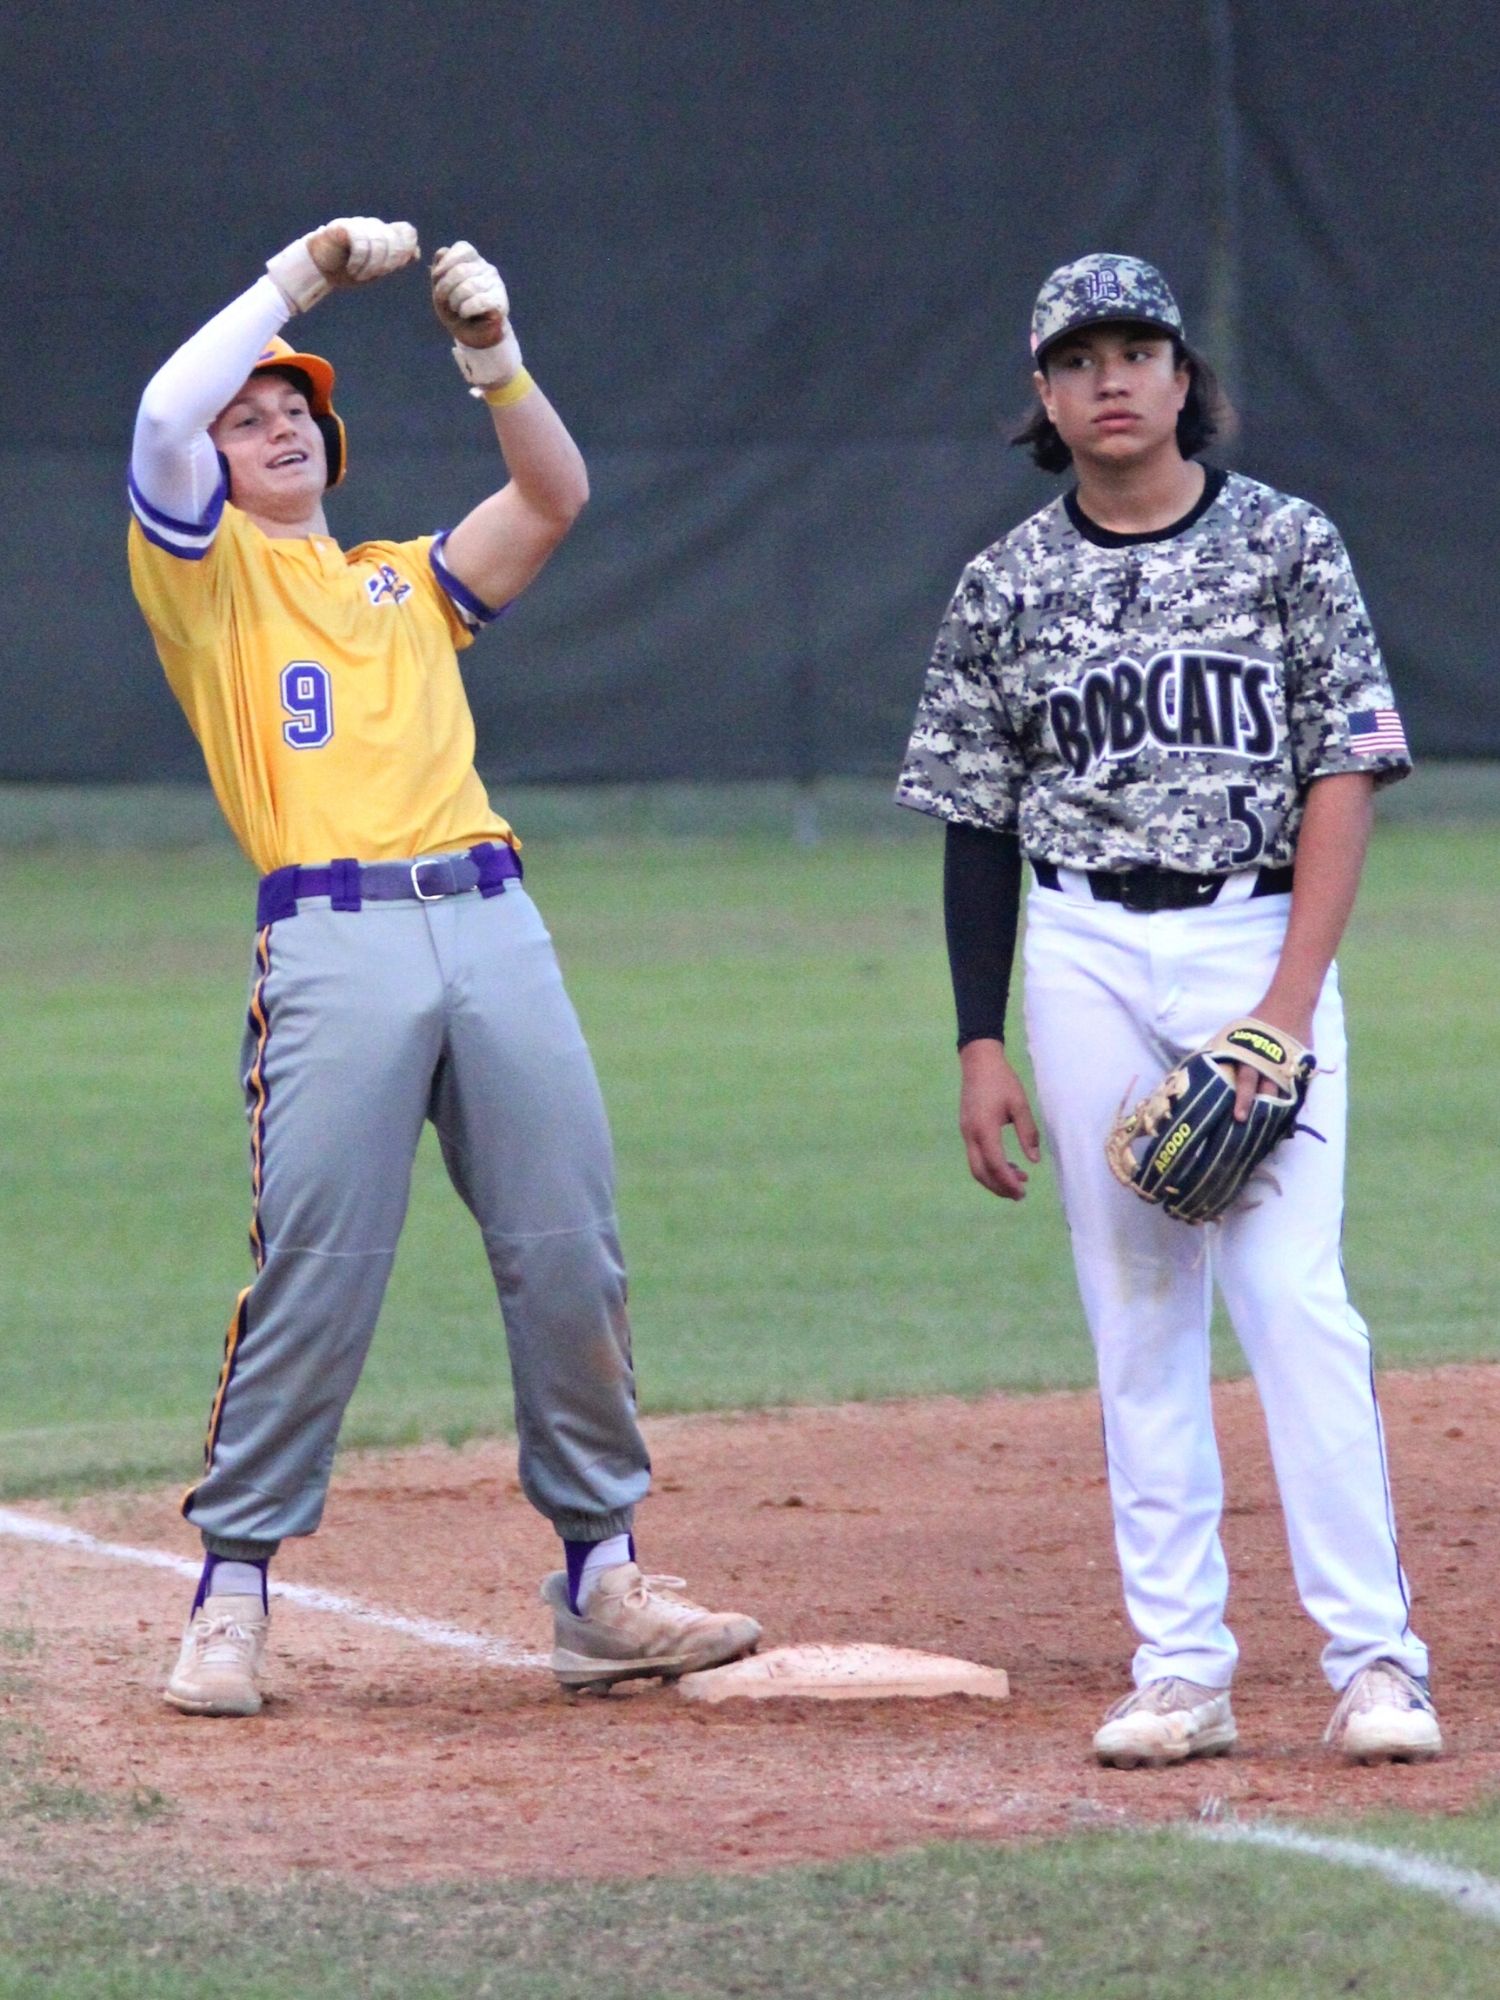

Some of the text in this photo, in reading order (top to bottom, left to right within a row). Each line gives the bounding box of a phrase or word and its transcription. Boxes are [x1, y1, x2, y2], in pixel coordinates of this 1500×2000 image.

[1086, 268, 1122, 301] B
[281, 660, 334, 750] 9
[1048, 650, 1278, 779] BOBCATS
[1226, 784, 1265, 865] 5
[1154, 1123, 1192, 1174] A2000
